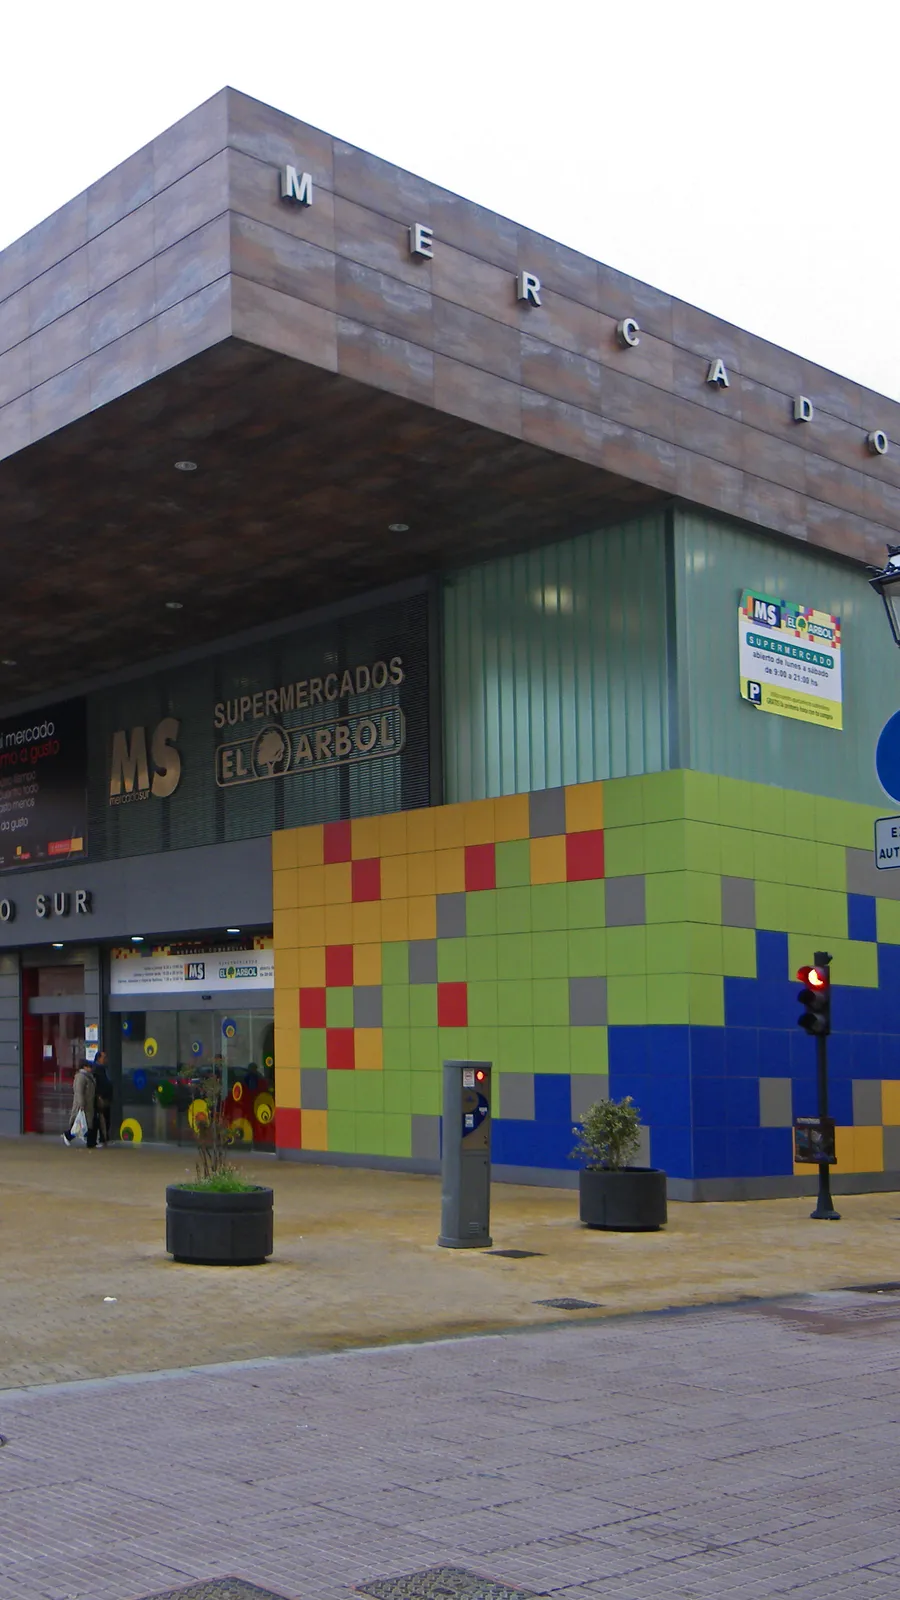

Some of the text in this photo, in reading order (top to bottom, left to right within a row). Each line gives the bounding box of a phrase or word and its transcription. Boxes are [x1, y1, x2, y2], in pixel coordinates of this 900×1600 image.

[755, 600, 777, 626] MS
[787, 616, 797, 629] EL
[808, 624, 833, 640] ARBOL
[748, 635, 832, 666] SUPERMERCADO
[753, 650, 775, 663] abierto
[776, 657, 784, 666] de
[785, 660, 802, 671] lunes
[808, 666, 829, 678] sábado
[765, 666, 773, 675] de
[774, 669, 787, 678] 9:00
[793, 674, 810, 684] 21:00
[213, 656, 406, 729] SUPERMERCADOS
[5, 720, 55, 747] mercado
[30, 739, 60, 764] gusto
[110, 717, 181, 798] MS
[221, 716, 397, 779] EL ARBOL
[11, 816, 29, 832] gusto
[35, 889, 91, 918] SUR
[189, 963, 204, 980] MS
[219, 968, 227, 978] EL
[236, 966, 257, 977] ARBOL
